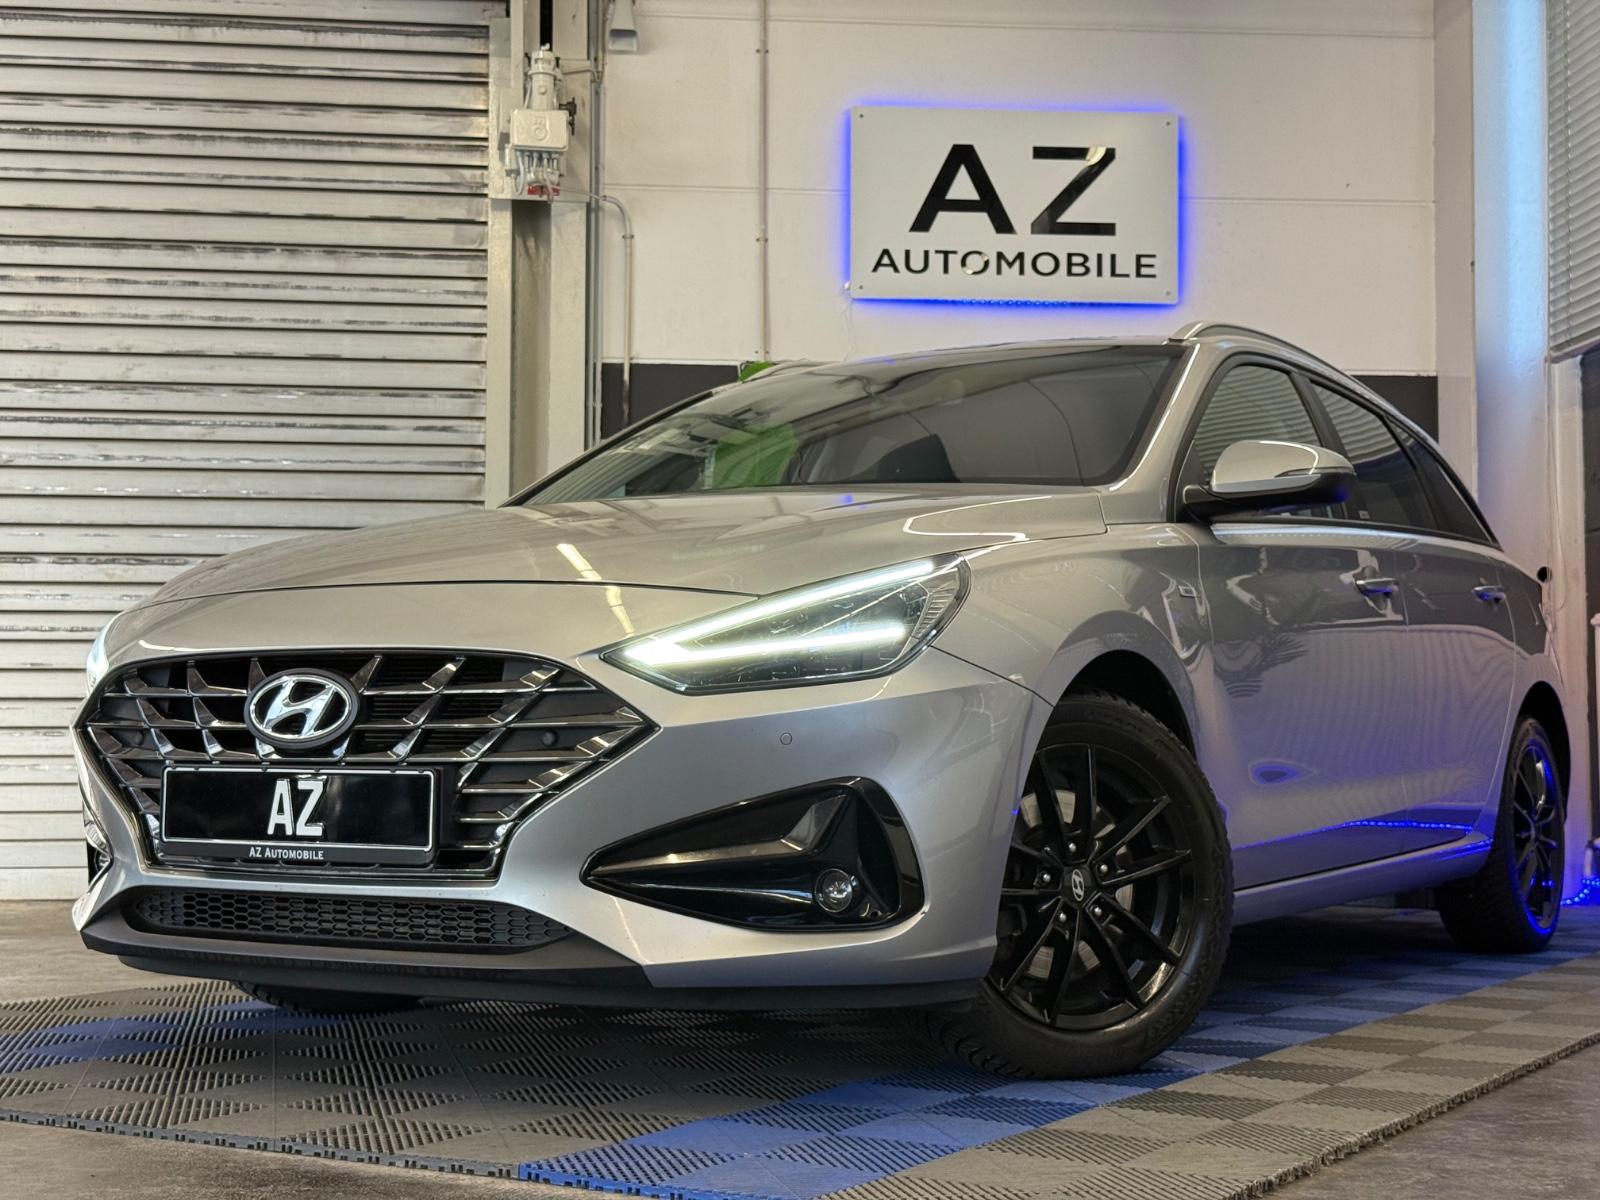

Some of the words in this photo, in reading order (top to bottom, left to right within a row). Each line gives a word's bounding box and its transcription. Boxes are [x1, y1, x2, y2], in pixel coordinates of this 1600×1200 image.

[909, 143, 1117, 237] AZ
[871, 248, 1157, 279] AUTOMOBILE
[267, 777, 324, 837] AZ
[249, 846, 262, 858] AZ
[264, 847, 324, 860] AUTOMOBILE
